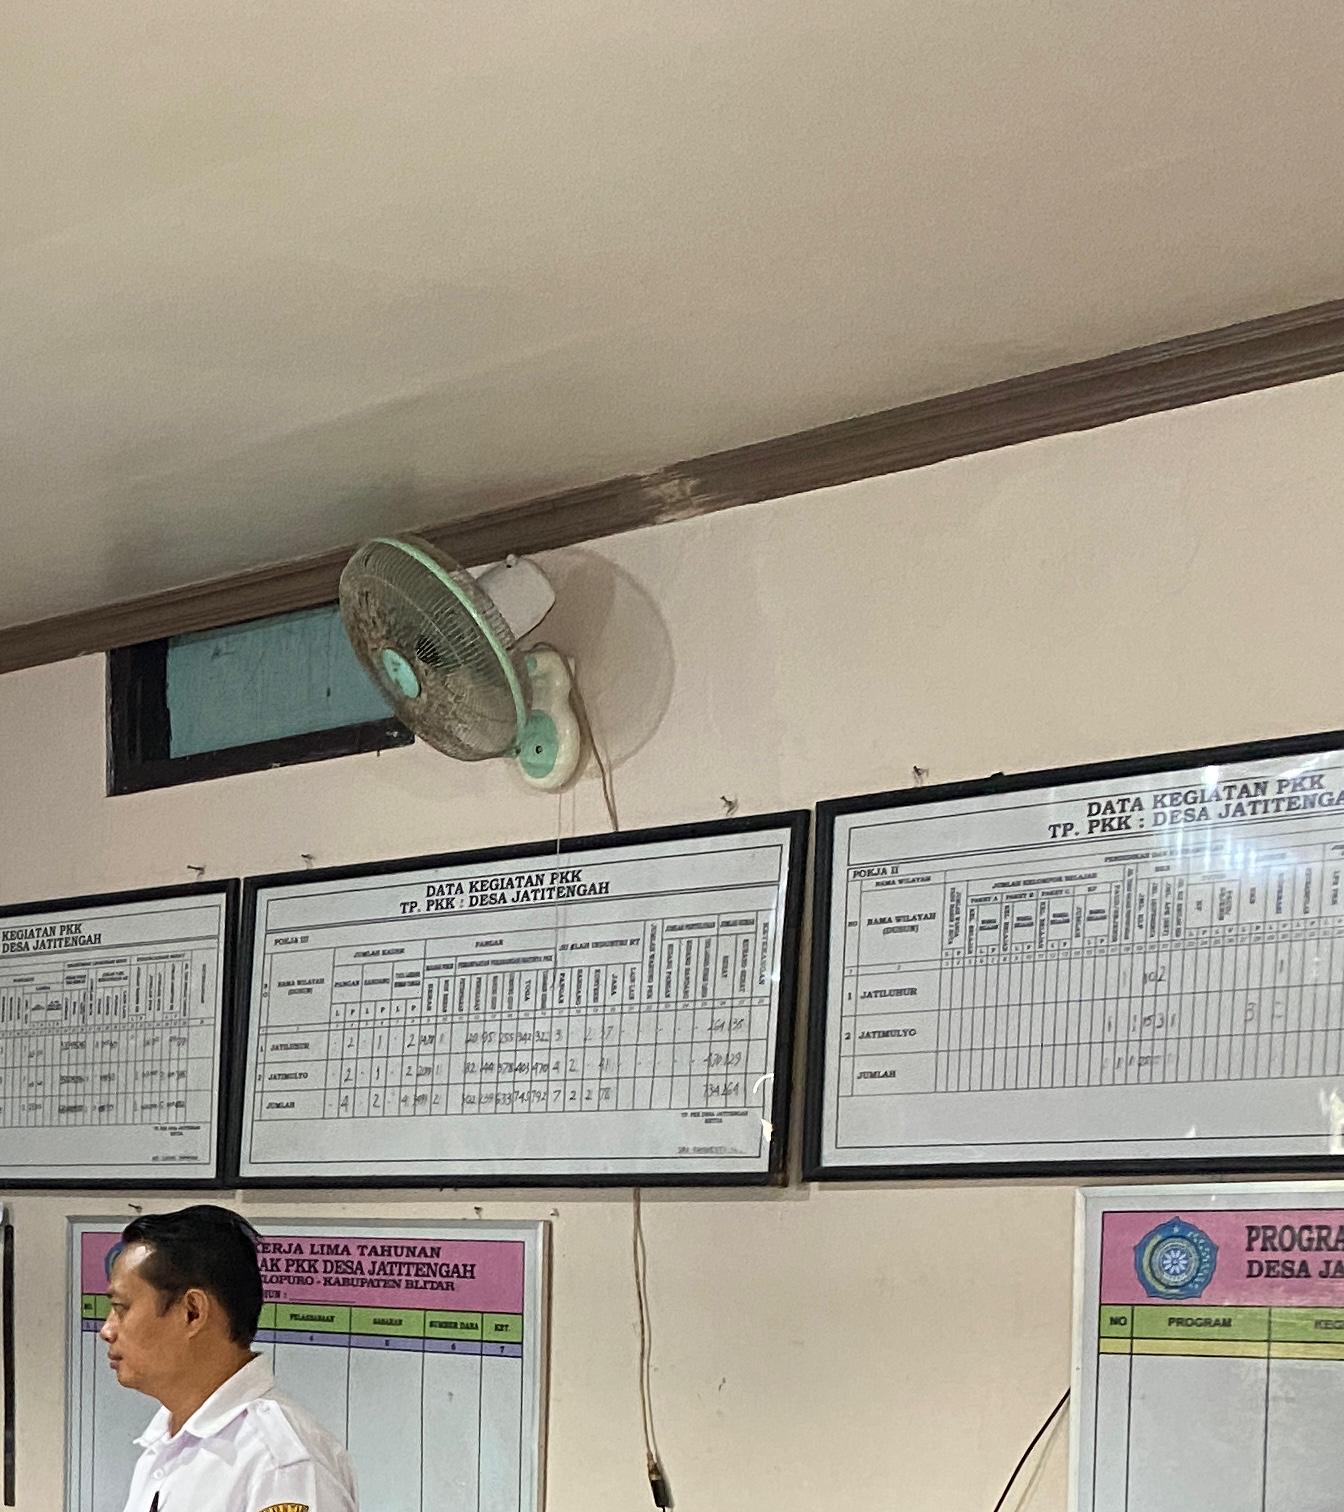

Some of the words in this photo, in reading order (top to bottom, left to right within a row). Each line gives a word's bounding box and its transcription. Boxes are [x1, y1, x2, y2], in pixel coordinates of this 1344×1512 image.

[1086, 797, 1145, 818] DATA
[1151, 780, 1269, 810] KEGIATAN
[1275, 773, 1325, 796] PKK
[1048, 822, 1080, 839] TP.
[1087, 814, 1133, 835] PKK
[1151, 806, 1210, 828] DESA
[853, 867, 889, 879] POKJA
[425, 882, 464, 898] DATA
[468, 872, 545, 894] KEGIATAN
[549, 869, 583, 885] PKK
[400, 900, 421, 914] TP.
[426, 898, 456, 913] PKK
[468, 892, 507, 908] DESA
[510, 881, 610, 904] JATITENGAH
[1, 925, 57, 942] KEGIATAN
[59, 923, 83, 936] PKK
[1, 940, 30, 953] DESA
[32, 933, 102, 951] JATITENGAH
[859, 987, 918, 999] JATILUHUR
[309, 1243, 352, 1256] LIMA
[356, 1244, 442, 1259] TAHUNAN
[284, 1259, 320, 1274] PKK
[322, 1260, 366, 1276] DESA
[367, 1261, 476, 1280] JATITENGAH
[1246, 1259, 1312, 1279] DESA
[261, 1274, 314, 1286] LOPURO
[322, 1276, 402, 1289] KABUPATEN
[1167, 1316, 1232, 1328] PROGRAM
